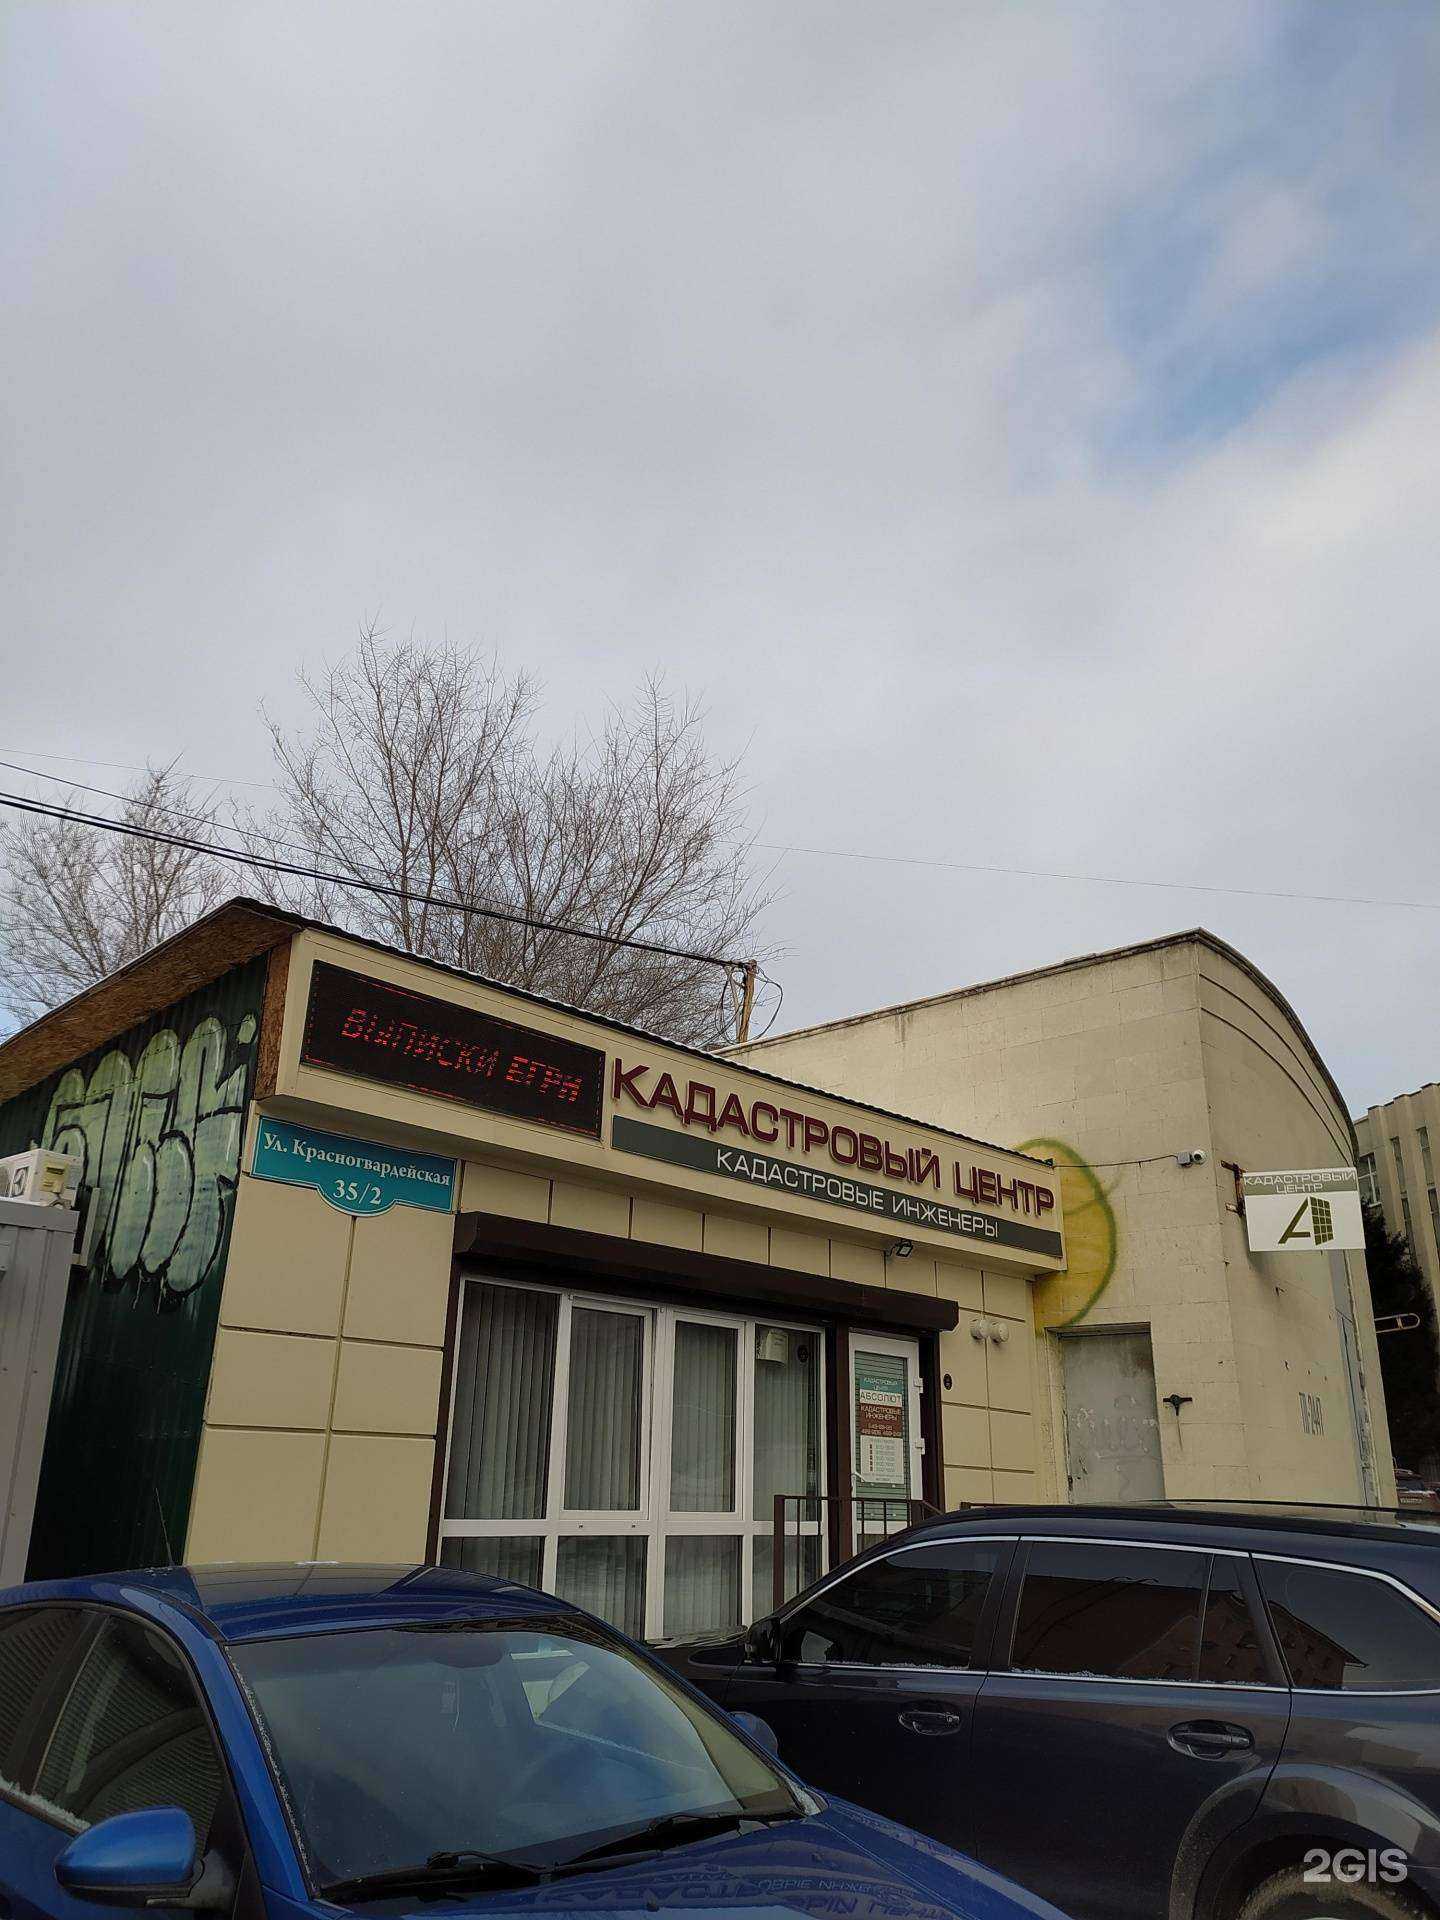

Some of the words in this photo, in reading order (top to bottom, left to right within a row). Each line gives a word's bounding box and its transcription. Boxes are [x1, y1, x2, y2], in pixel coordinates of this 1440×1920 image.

[612, 1057, 941, 1189] КАДАСТРОВЫЙ
[953, 1161, 1056, 1216] ЦЕНТР
[263, 1132, 289, 1154] Ул.
[292, 1143, 451, 1187] Красногвардейская
[1244, 1169, 1356, 1186] КАДАСТРОВЫЙ
[1276, 1183, 1323, 1194] ЦЕНТР
[332, 1179, 383, 1206] 35/2
[716, 1149, 884, 1211] КАДАСТРОВЫЕ
[892, 1195, 999, 1238] ИНЖЕНЕРЫ
[860, 1391, 902, 1404] АБСОЛЮТ
